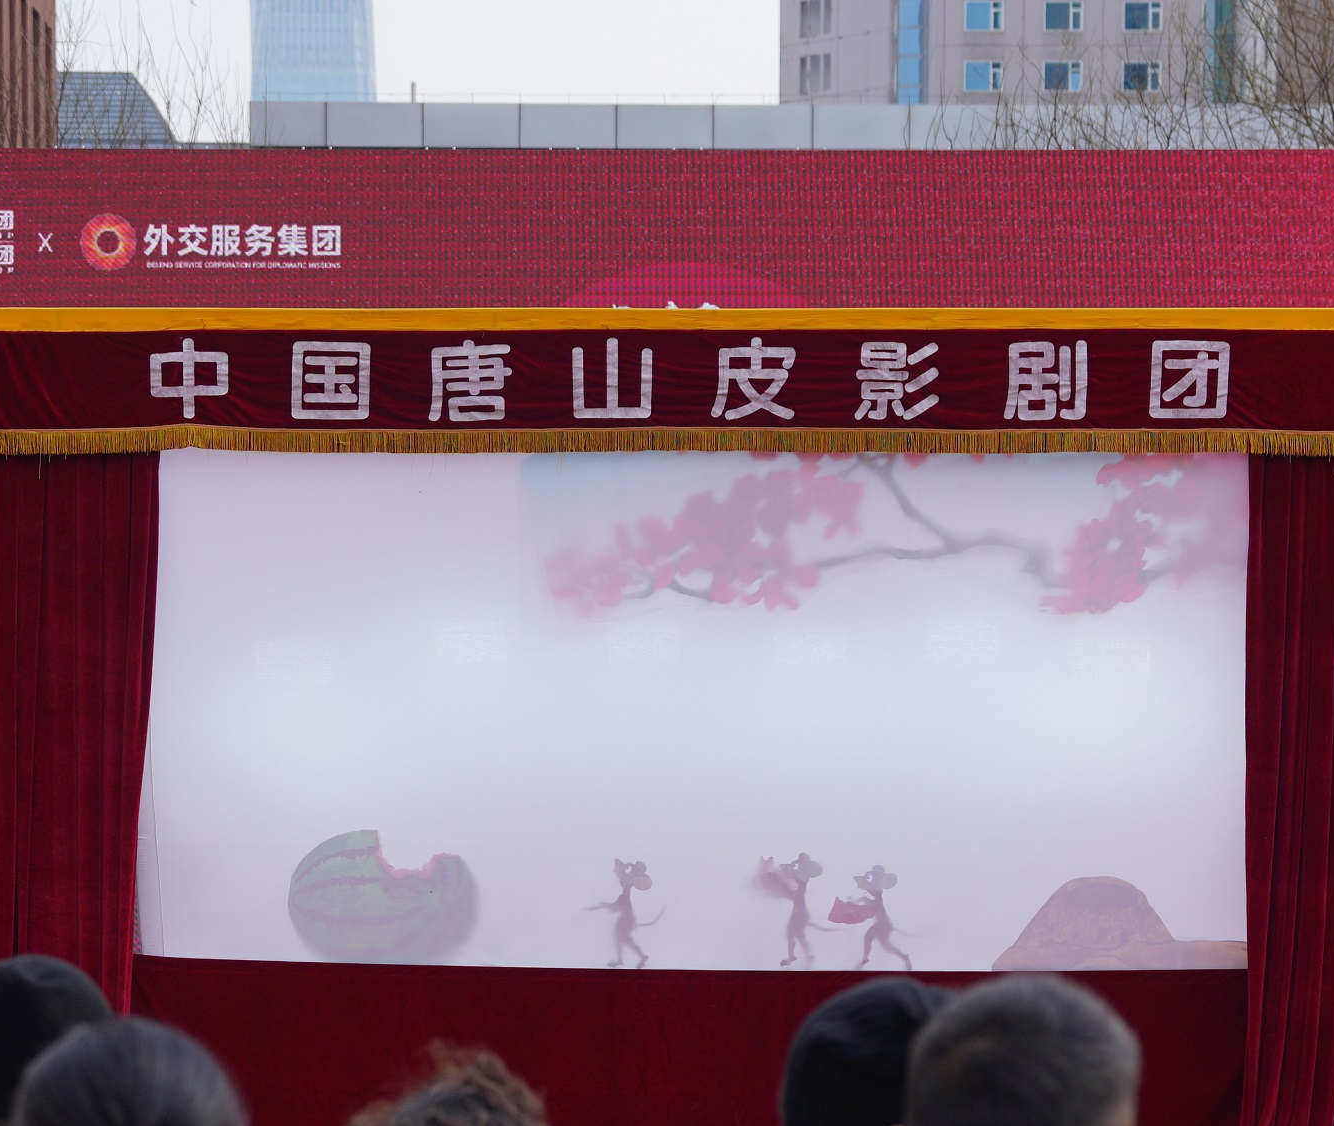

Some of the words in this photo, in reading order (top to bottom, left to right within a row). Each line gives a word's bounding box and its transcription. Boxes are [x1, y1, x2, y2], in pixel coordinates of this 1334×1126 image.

[143, 223, 342, 257] 外交服务集团
[150, 338, 1229, 422] 中国唐山皮影剧团
